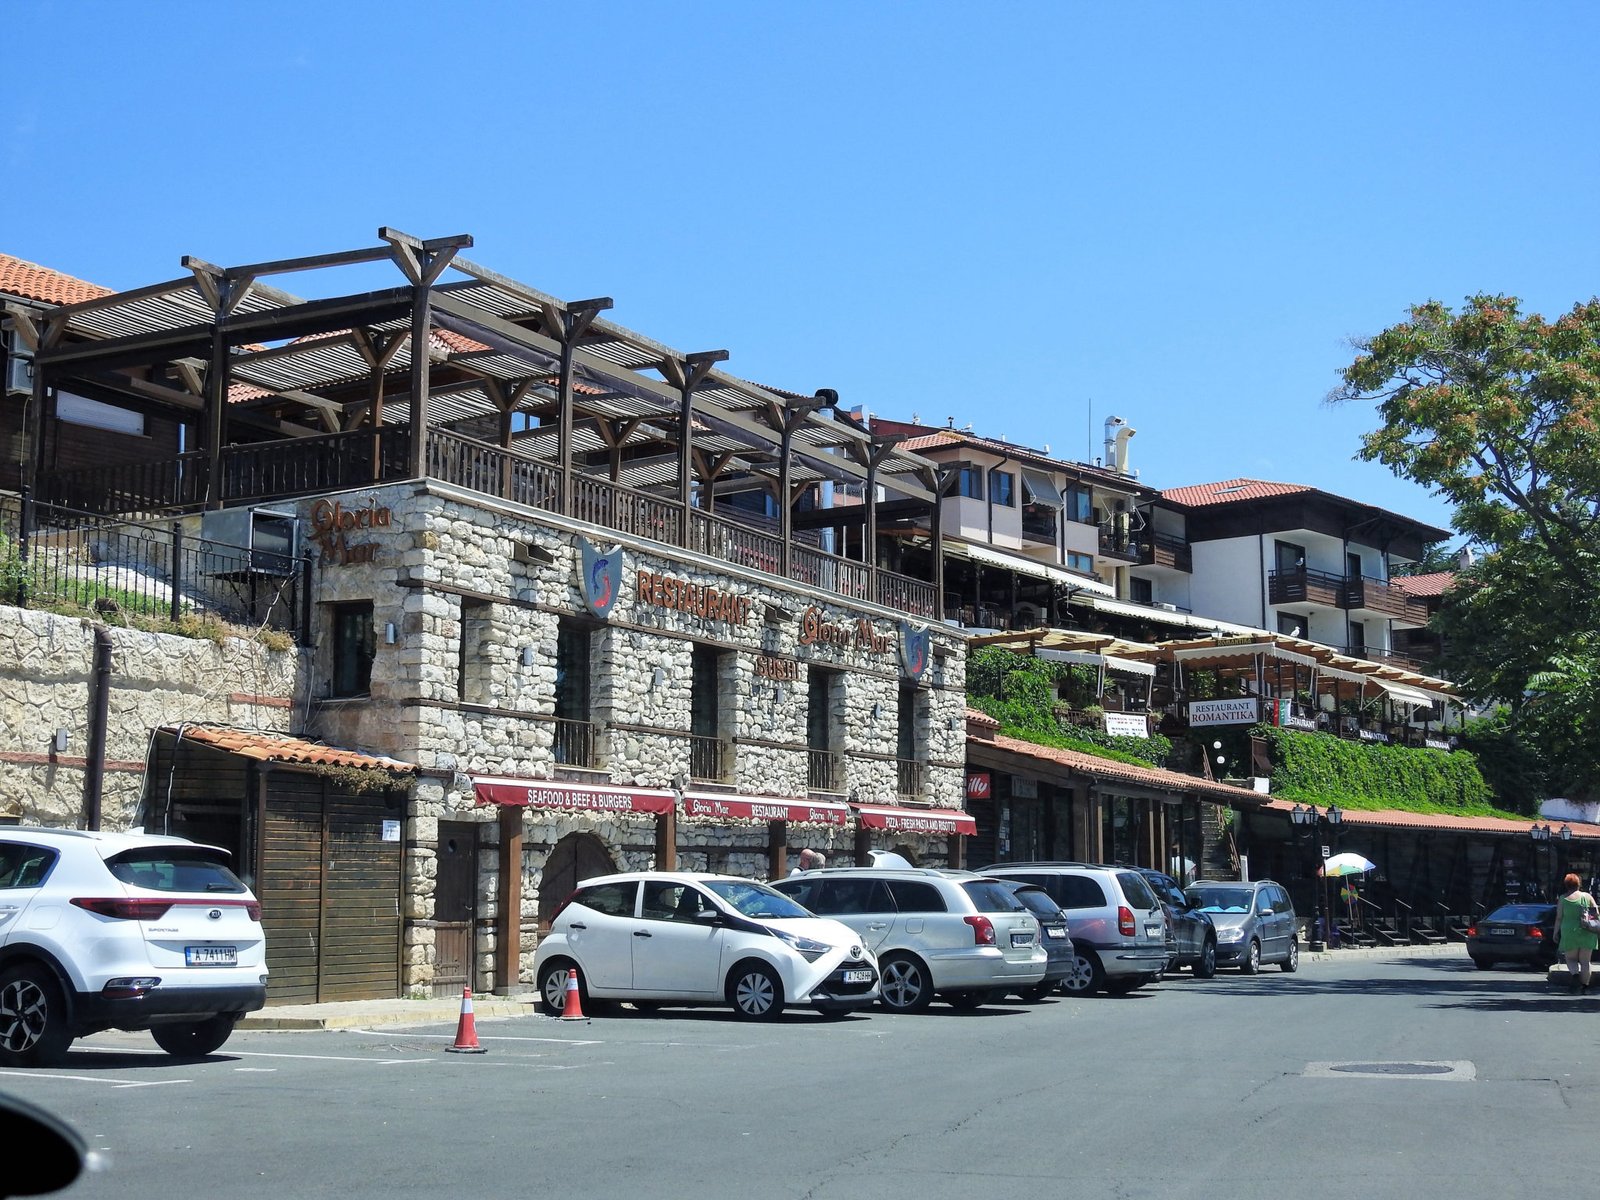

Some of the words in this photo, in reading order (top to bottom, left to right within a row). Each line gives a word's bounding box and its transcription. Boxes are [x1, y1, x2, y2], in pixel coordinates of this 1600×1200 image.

[306, 496, 392, 540] Gloria
[638, 570, 751, 626] RESTAURANT
[800, 606, 850, 645] Gloria
[856, 618, 892, 654] Mar
[755, 656, 800, 681] SUSHI
[1195, 702, 1251, 713] RESTAURANT
[1192, 710, 1255, 723] ROMANTIKA
[968, 777, 988, 796] illy
[527, 789, 564, 805] SEAFOOD
[565, 793, 570, 804] &
[572, 793, 591, 807] BEEF
[592, 794, 597, 807] &
[598, 794, 632, 809] BURGERS
[692, 799, 712, 813] Gloria
[714, 801, 729, 814] Mar
[751, 804, 789, 819] RESTAURANT
[809, 808, 825, 821] Gloria
[827, 809, 840, 822] Mar
[885, 816, 898, 828] PIZZA
[901, 817, 916, 829] FRESH
[916, 818, 929, 830] PASTA
[929, 820, 938, 830] AND
[938, 820, 956, 832] RISOTTO
[196, 949, 201, 961] A
